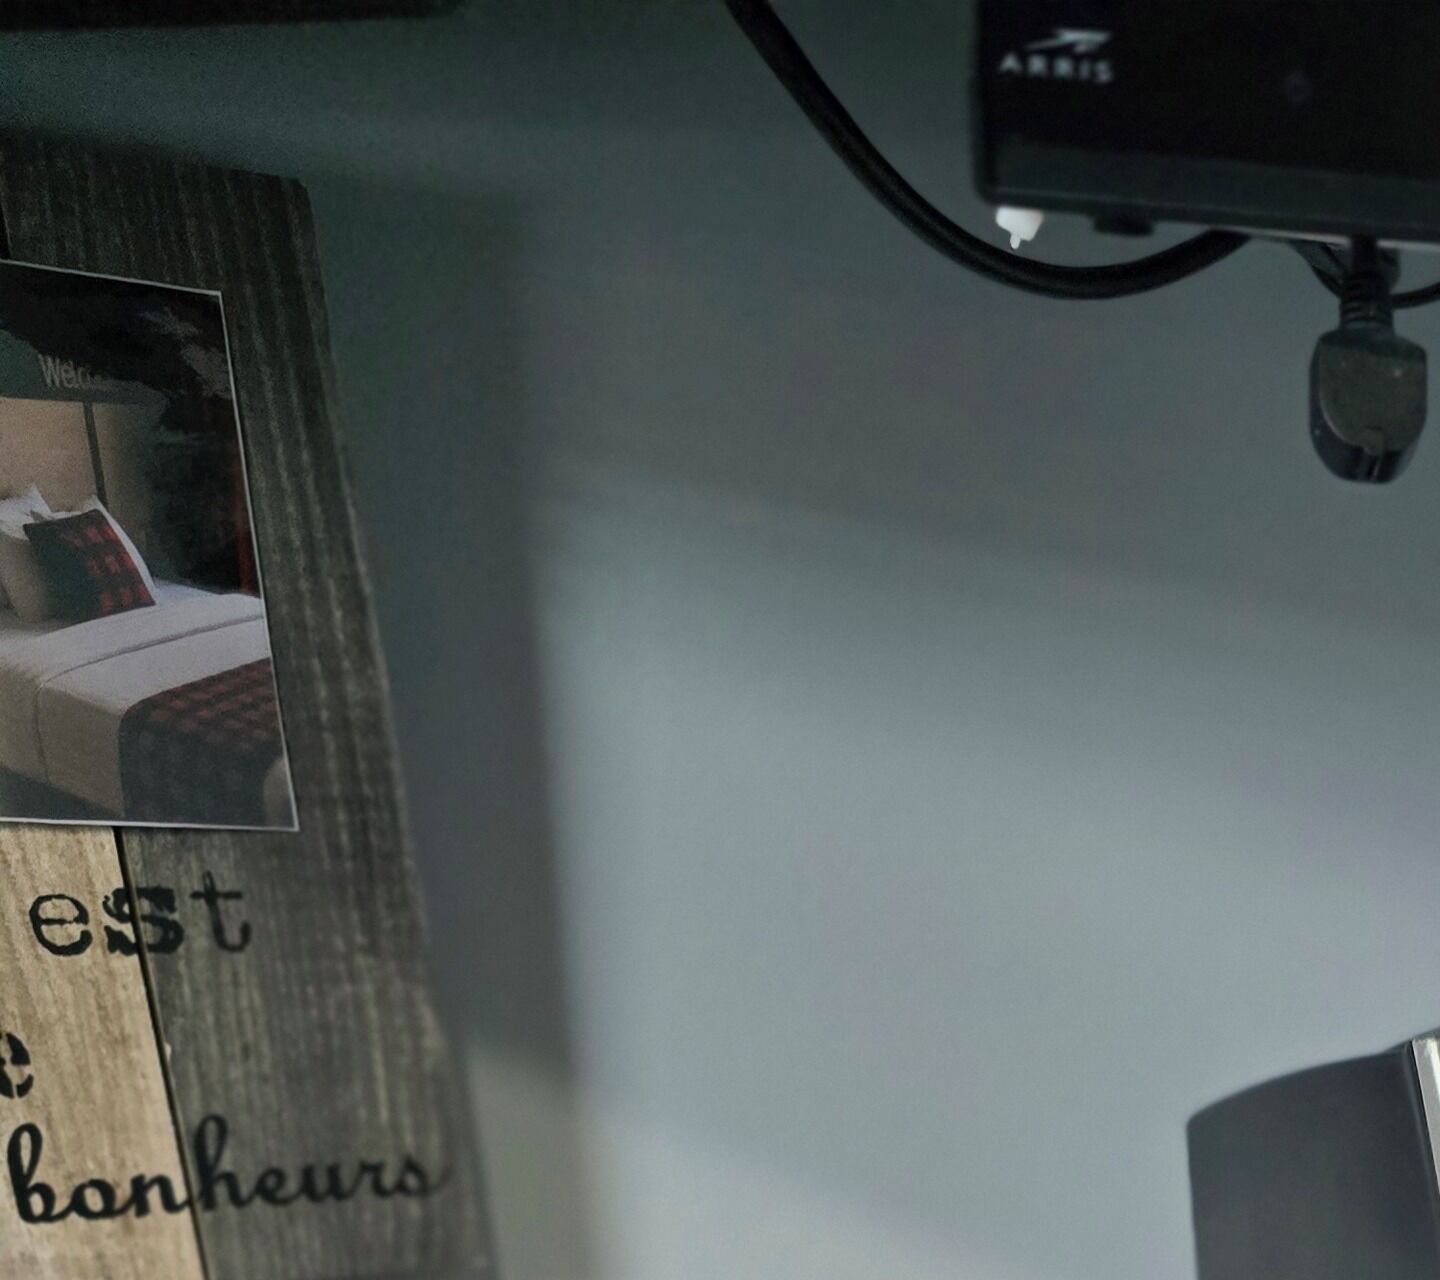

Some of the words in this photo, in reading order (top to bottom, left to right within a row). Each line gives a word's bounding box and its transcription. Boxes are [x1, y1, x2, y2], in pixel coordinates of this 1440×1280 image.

[998, 53, 1113, 83] ARRIS
[29, 869, 252, 956] est
[8, 1114, 451, 1224] bonheurs
